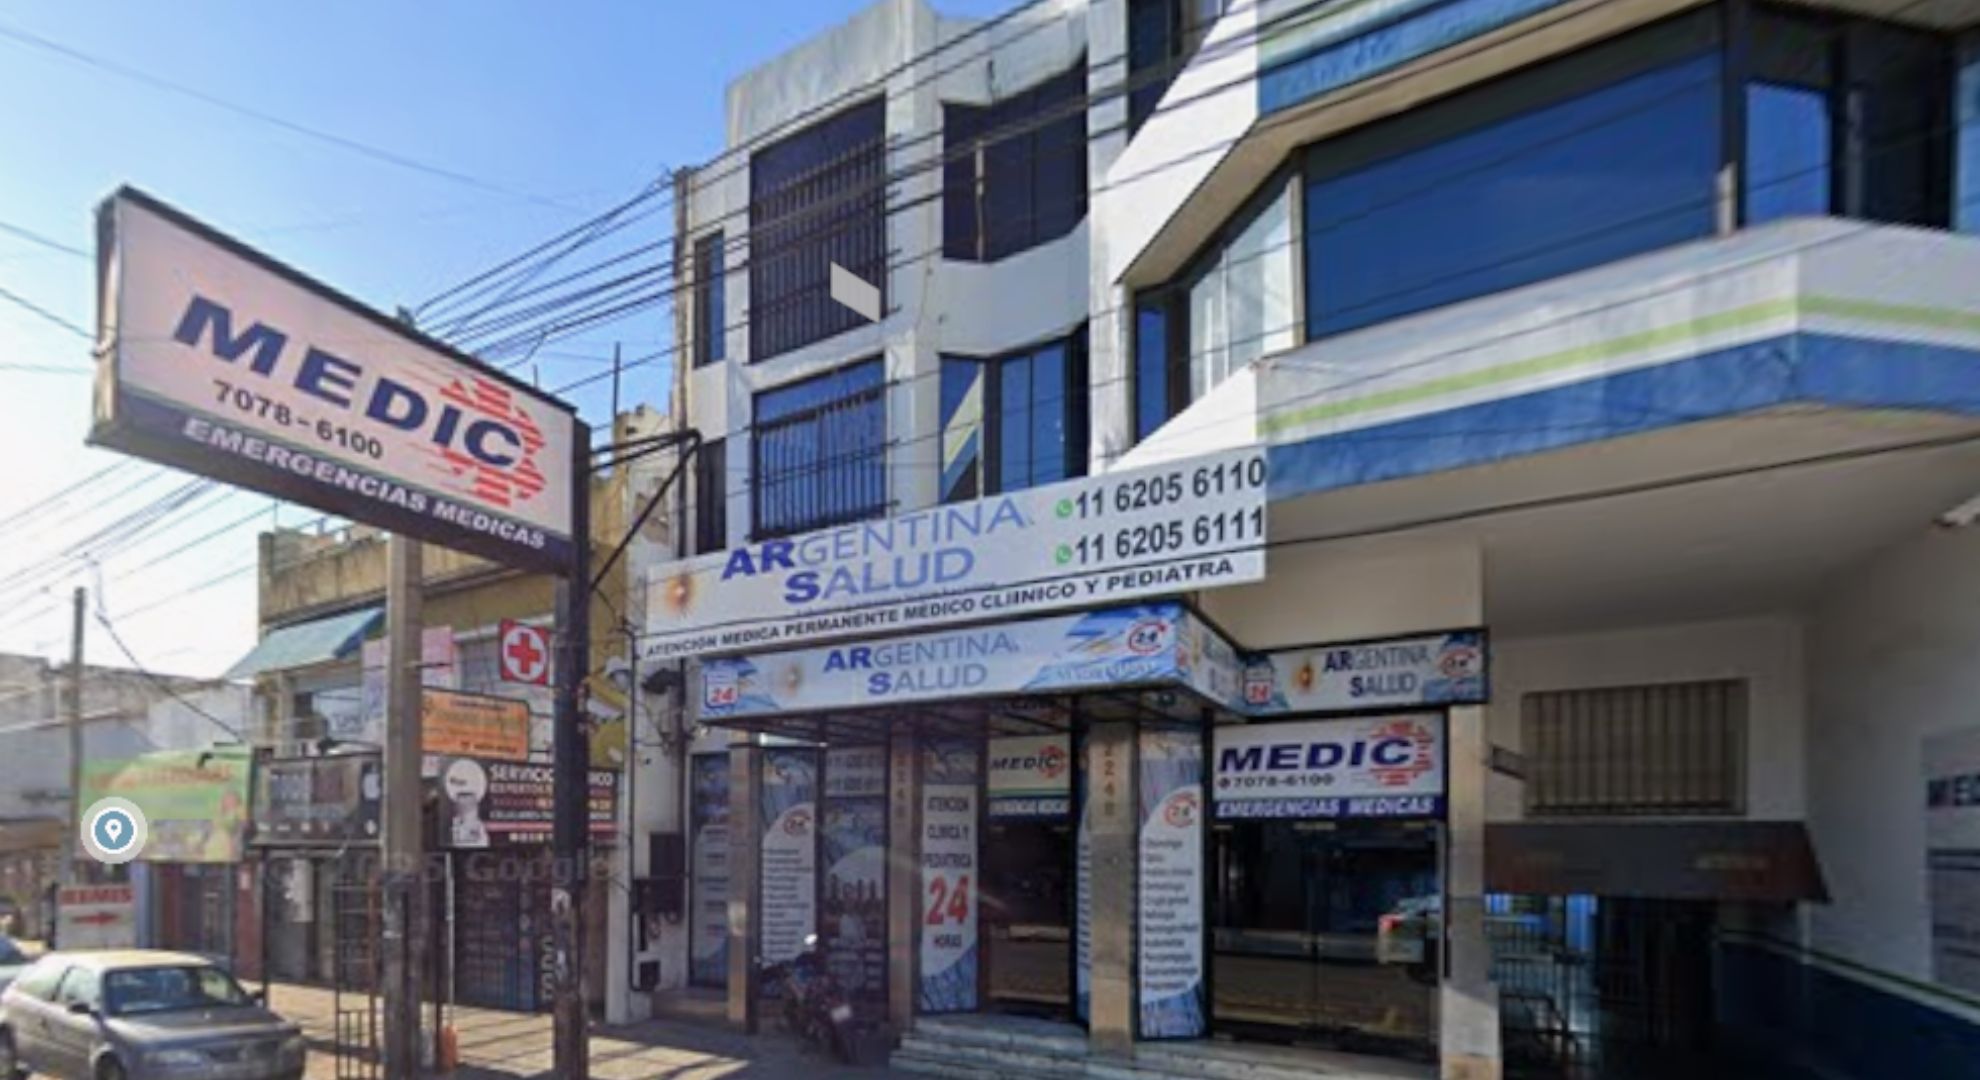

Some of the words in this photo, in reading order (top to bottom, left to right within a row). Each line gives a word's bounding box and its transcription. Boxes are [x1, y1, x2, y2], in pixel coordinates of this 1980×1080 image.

[174, 294, 522, 467] MEDIC
[182, 417, 429, 513] EMERGENCIAS
[431, 499, 546, 550] MEDICAS
[1075, 488, 1104, 519] 11
[1115, 472, 1183, 513] 6205
[1191, 456, 1266, 498] 6110
[721, 497, 1026, 581] ARGENTINA
[1074, 533, 1105, 565] 11
[1115, 518, 1184, 559] 6205
[1191, 505, 1264, 546] 6111
[784, 546, 975, 604] SALUD
[784, 608, 899, 637] PERMANENTE
[1085, 579, 1100, 595] Y
[1107, 559, 1234, 592] PEDIATRA
[823, 631, 1014, 673] ARGENTINA
[1324, 646, 1430, 673] ARGENTINA
[711, 686, 735, 704] 24
[867, 661, 988, 696] SALUD
[1350, 672, 1417, 697] SALUD
[990, 754, 1058, 770] MEDIC
[1218, 736, 1412, 773] MEDIC
[1216, 797, 1340, 818] EMERGENCIAS
[1347, 796, 1436, 815] MEDICAS
[926, 873, 970, 925] 24
